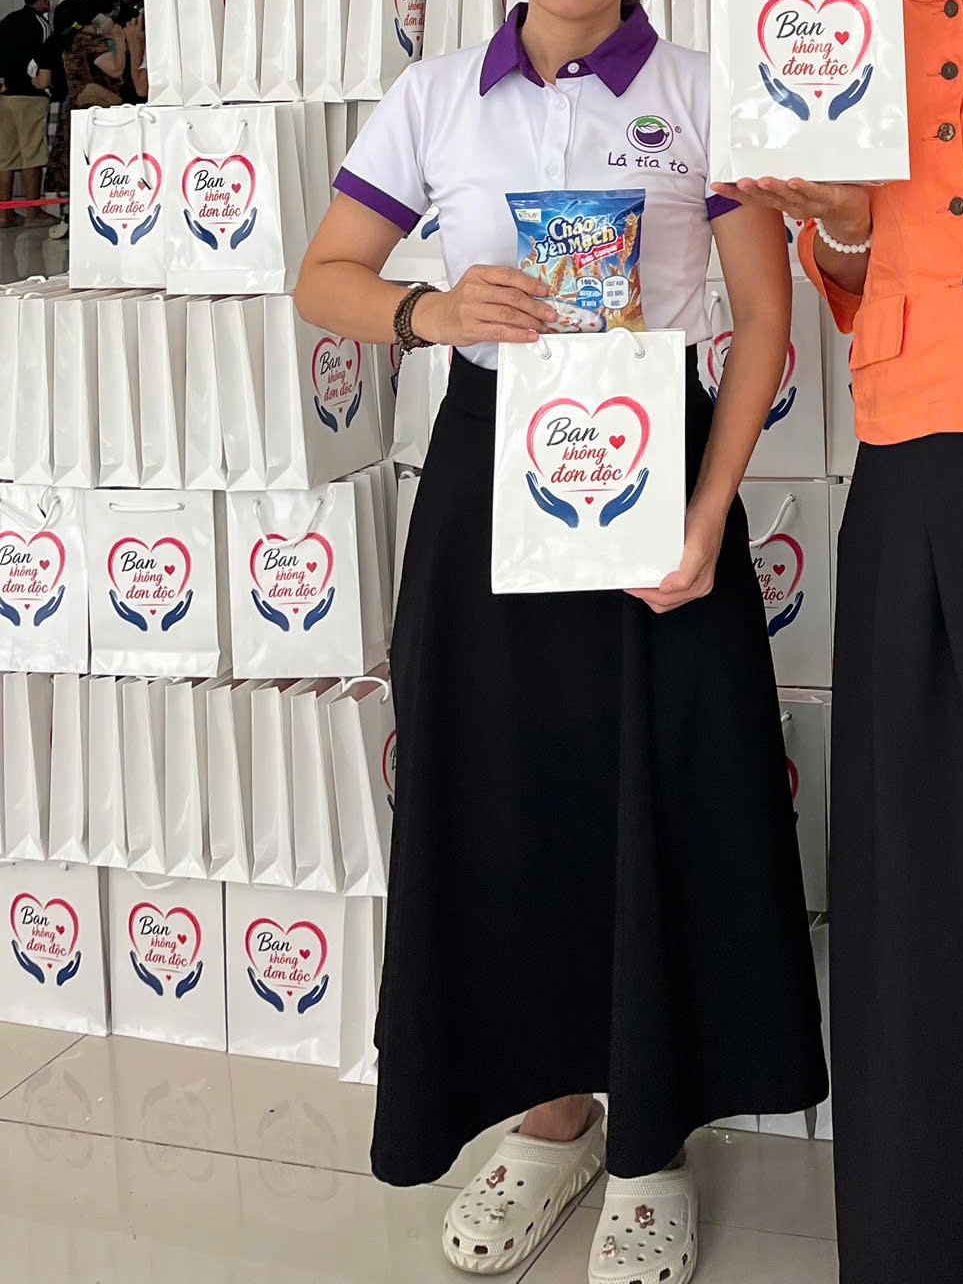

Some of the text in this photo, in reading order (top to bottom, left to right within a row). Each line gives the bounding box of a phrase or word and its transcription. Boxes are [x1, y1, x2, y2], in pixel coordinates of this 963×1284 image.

[776, 11, 825, 39] Bạn
[792, 38, 834, 59] không
[783, 57, 848, 79] đơn độc
[608, 152, 627, 166] Lá
[635, 156, 660, 168] tía
[100, 167, 130, 188] Bạn
[194, 170, 225, 191] Bạn
[109, 187, 136, 201] không
[204, 190, 231, 205] không
[102, 201, 145, 216] đơn độc
[199, 204, 241, 220] đơn độc
[549, 216, 594, 240] Cháo
[570, 227, 615, 252] Mạch
[546, 417, 599, 446] Bạn
[562, 444, 608, 465] không
[551, 463, 623, 485] đơn độc
[121, 551, 157, 572] Bạn
[263, 548, 299, 570] Bạn
[133, 572, 163, 586] không
[276, 568, 306, 584] không
[126, 585, 175, 602] đơn độc
[269, 583, 317, 599] đơn độc
[21, 906, 50, 926] Bạn
[139, 916, 171, 936] Bạn
[32, 926, 56, 942] không
[151, 935, 177, 953] không
[257, 932, 292, 952] Bạn
[27, 938, 66, 958] đơn độc
[145, 950, 188, 969] đơn độc
[270, 951, 299, 969] không
[264, 965, 311, 984] đơn độc
